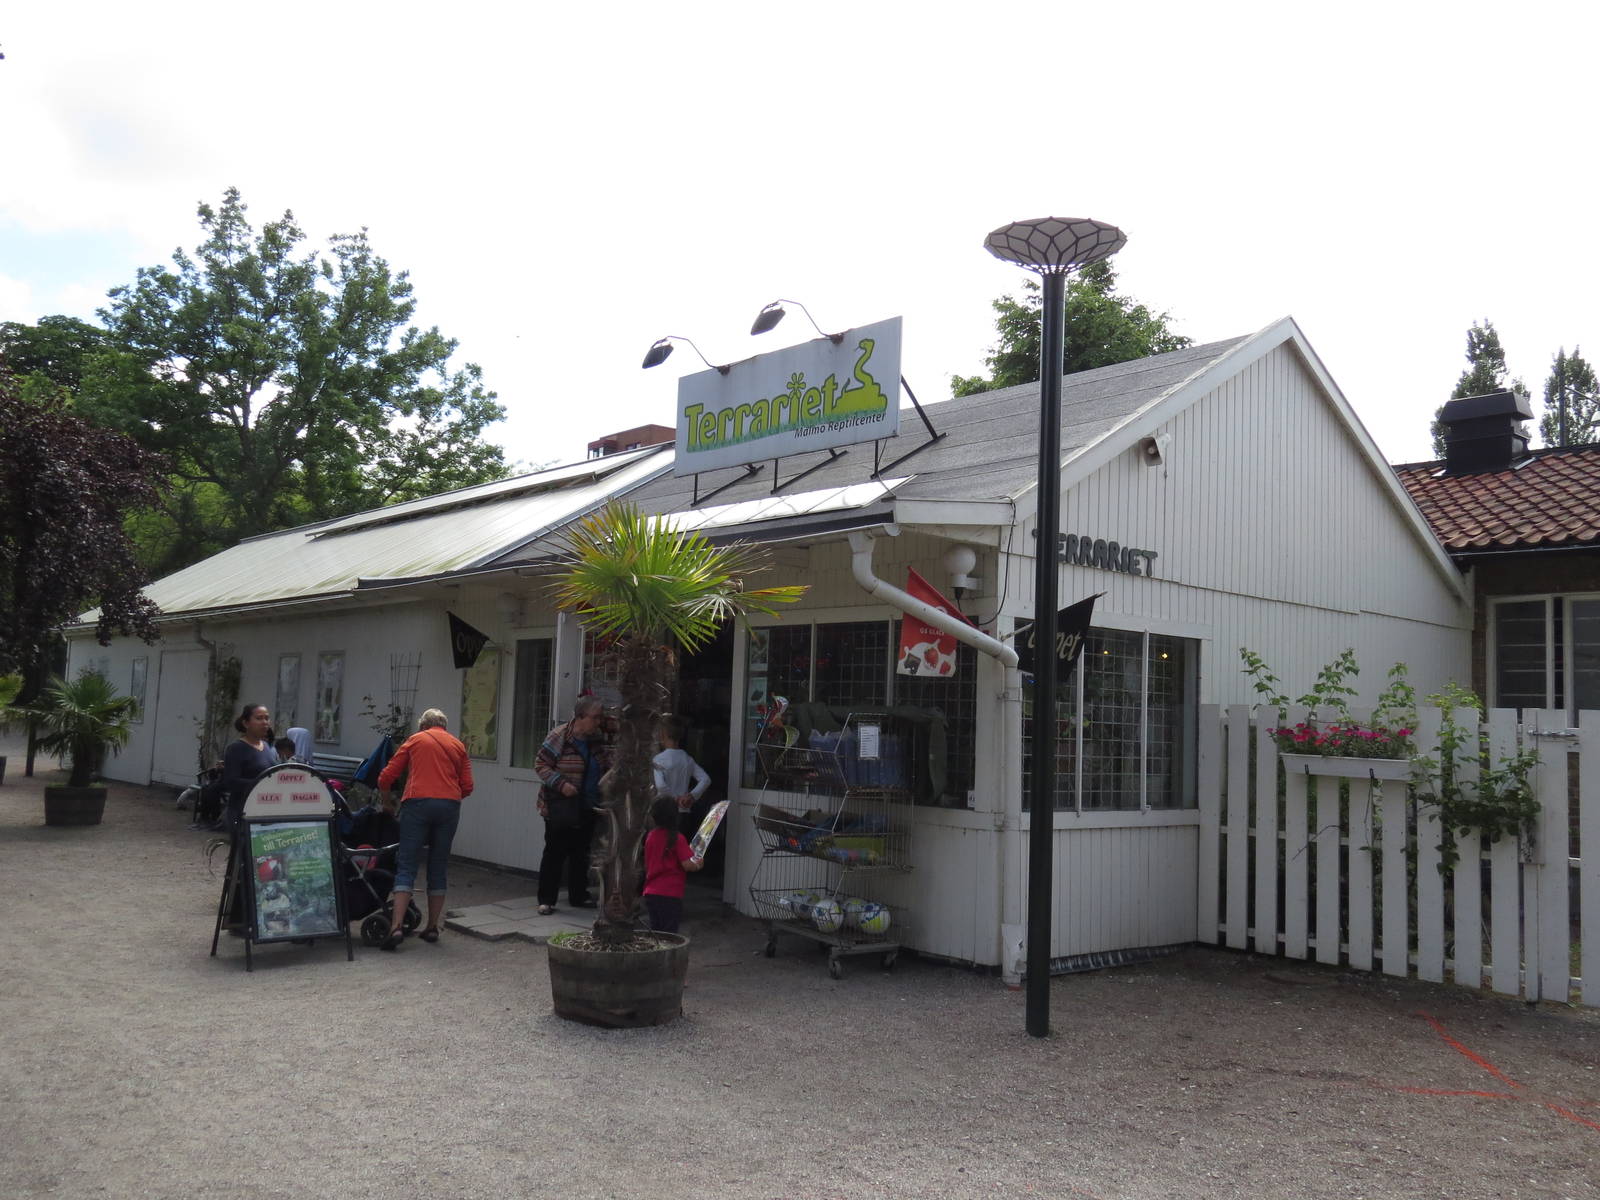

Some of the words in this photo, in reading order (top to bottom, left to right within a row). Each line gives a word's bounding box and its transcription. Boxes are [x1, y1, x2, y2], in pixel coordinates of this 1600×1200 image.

[684, 372, 839, 453] Terrariet
[827, 411, 886, 433] Reptilcenter
[1032, 528, 1158, 577] ERRARIET
